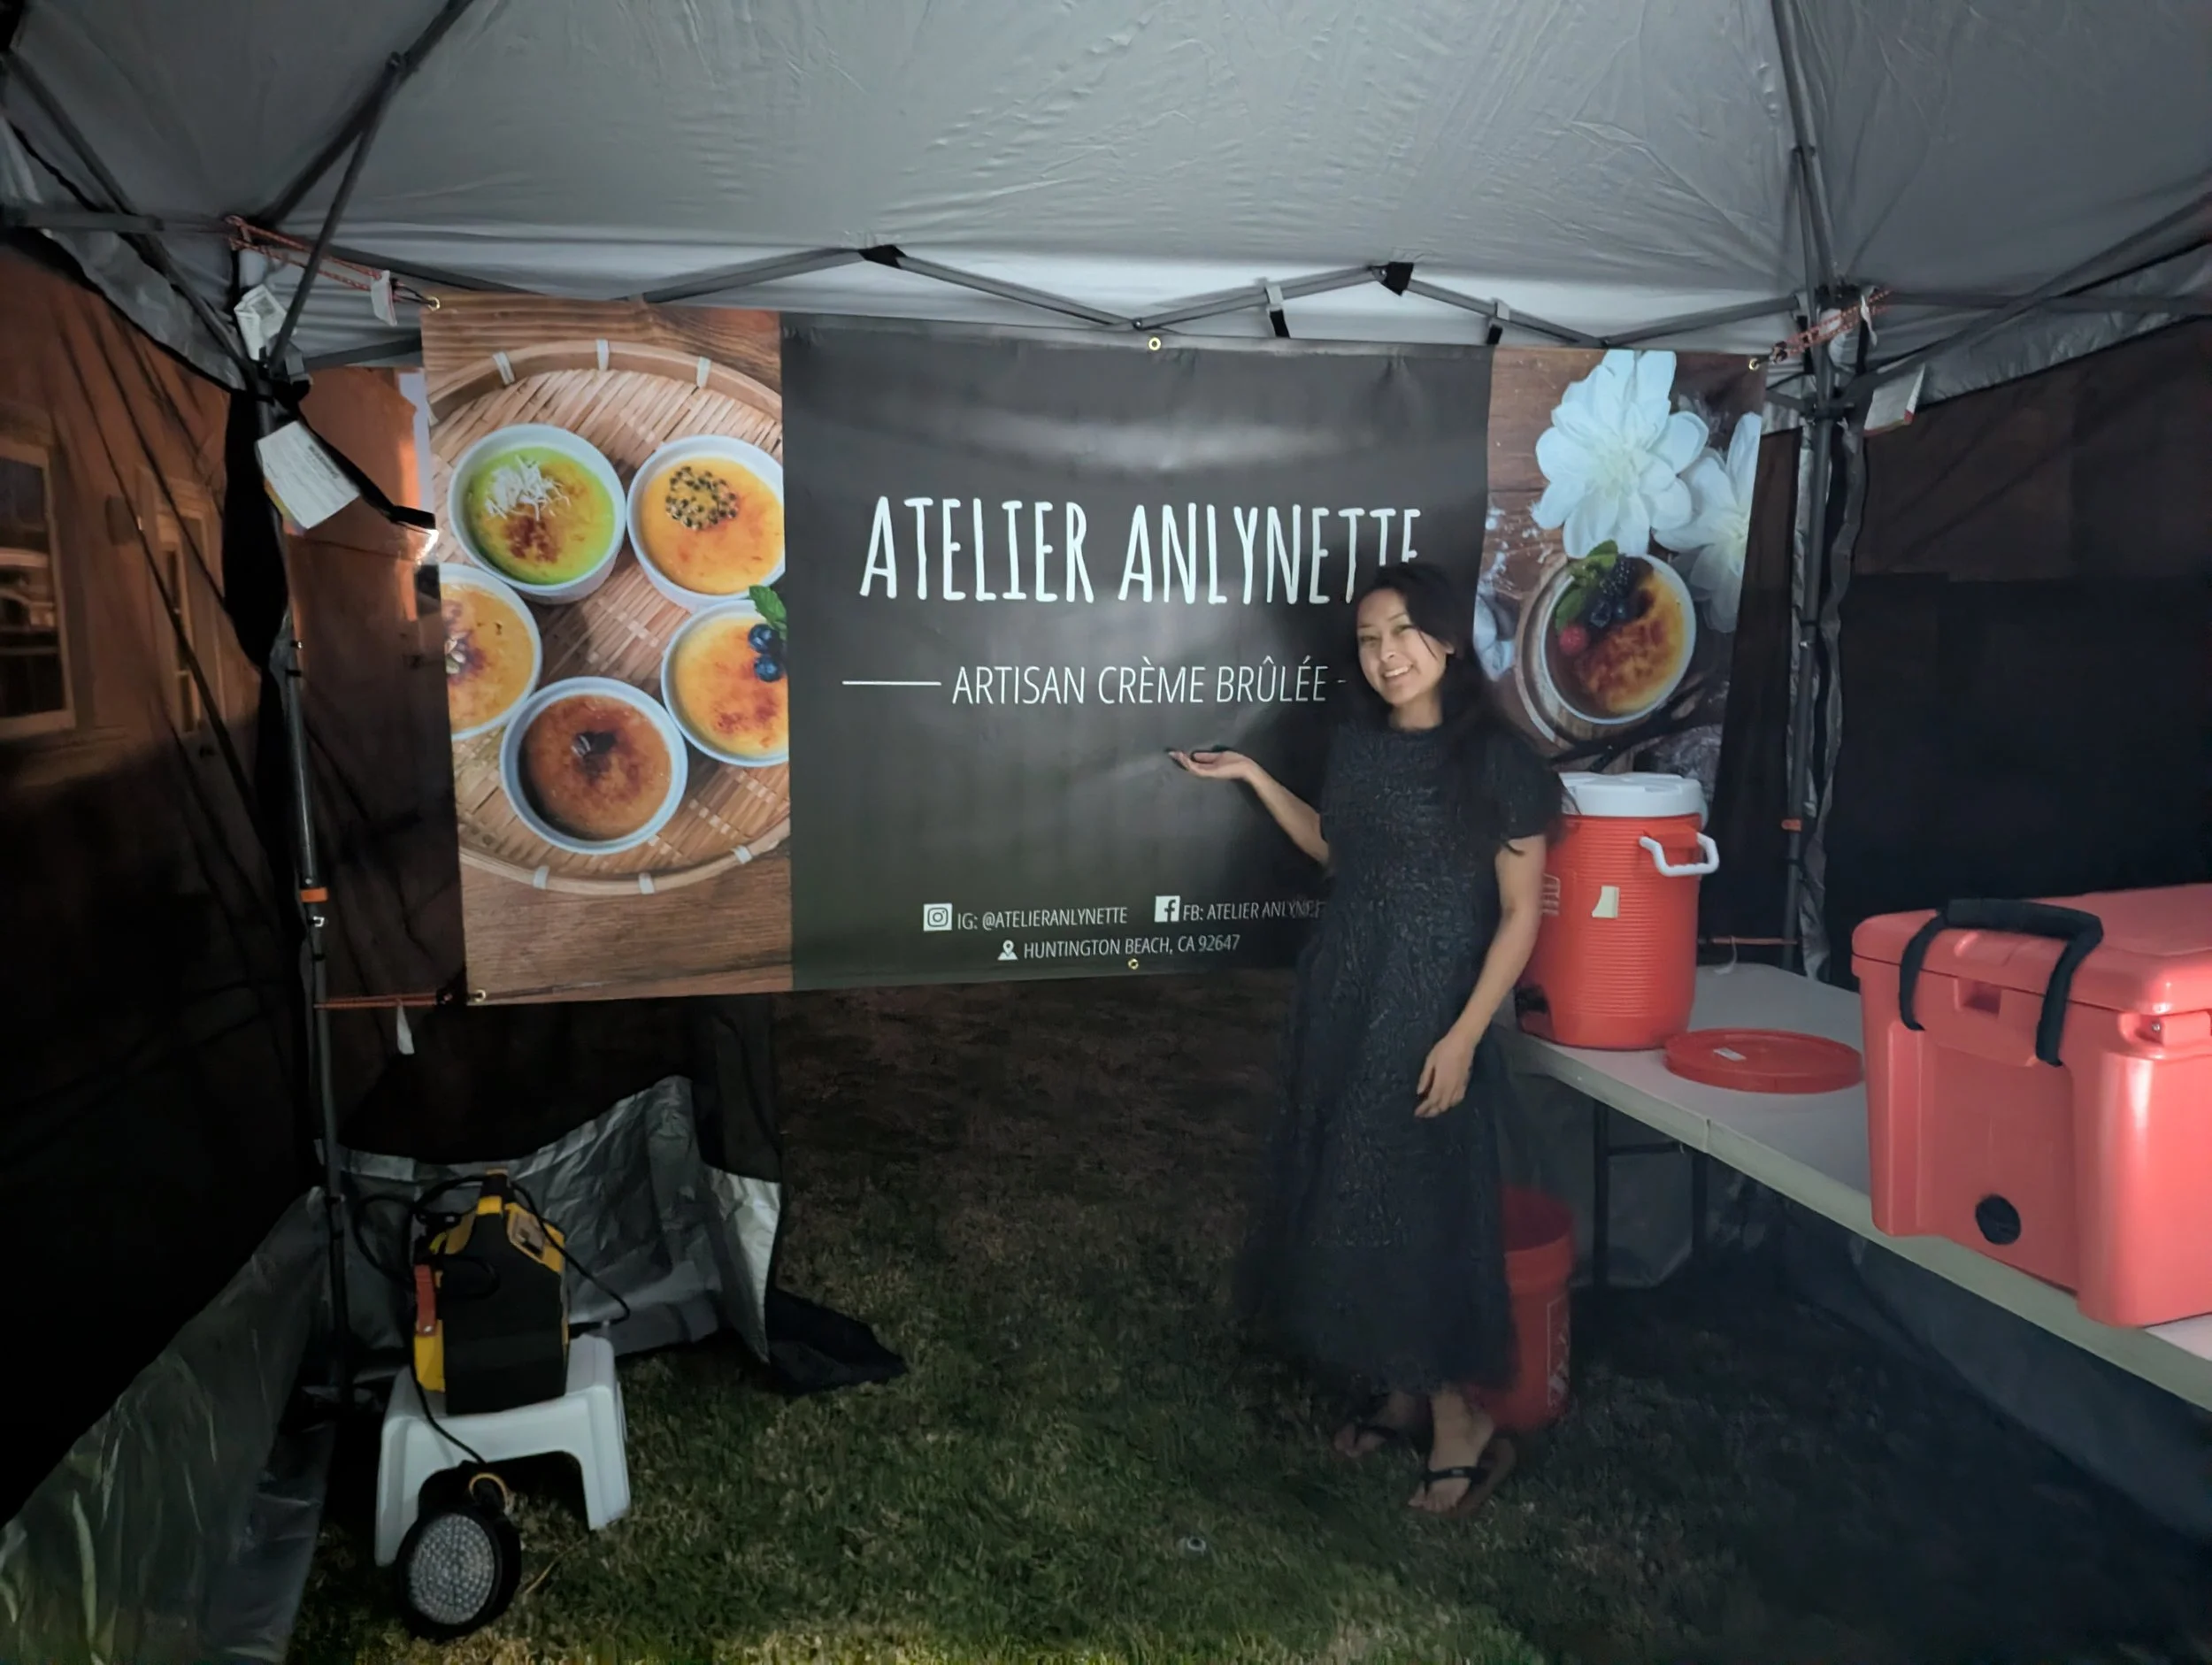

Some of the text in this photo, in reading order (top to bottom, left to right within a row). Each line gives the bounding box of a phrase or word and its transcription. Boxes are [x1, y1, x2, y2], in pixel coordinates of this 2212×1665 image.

[859, 495, 1095, 603] ATELIER
[951, 655, 1328, 705] ARTISAN CRÈME BRÛLÉE
[957, 907, 1129, 932] IG: @ATELIERANLYNETTE
[1182, 903, 1204, 922] FB:
[1207, 902, 1259, 921] ATELIER
[1024, 933, 1241, 960] HUNTINGTON BEACH, CA 92647
